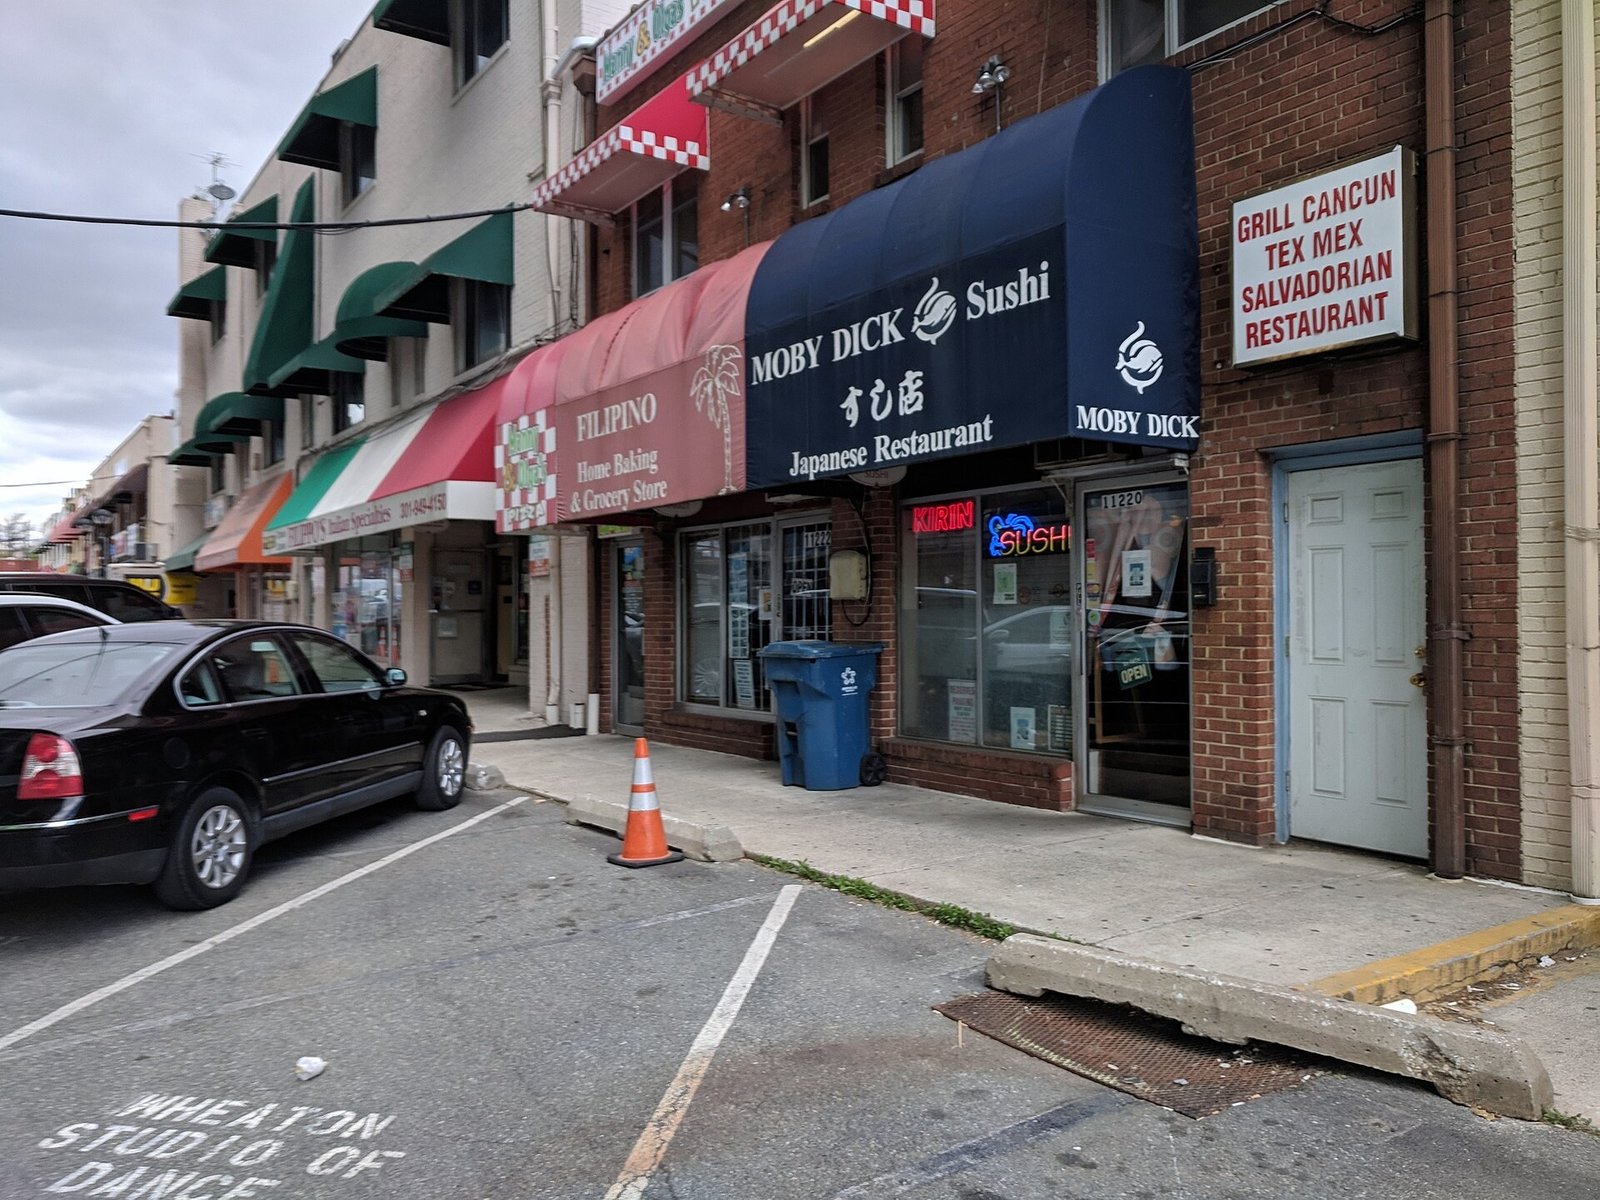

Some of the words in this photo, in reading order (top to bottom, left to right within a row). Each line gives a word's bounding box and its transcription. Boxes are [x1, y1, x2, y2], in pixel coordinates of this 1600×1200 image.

[1238, 203, 1295, 243] GRILL
[1302, 169, 1396, 224] CANCUN
[1265, 236, 1305, 271] TEX
[1313, 218, 1364, 259] MEX
[1242, 250, 1393, 313] SALVADORIAN
[751, 335, 823, 385] MOBY
[831, 308, 906, 362] DICK
[966, 260, 1051, 320] Sushi
[1246, 291, 1389, 349] RESTAURANT
[577, 393, 657, 442] FILIPINO
[1076, 405, 1142, 435] MOBY
[1147, 413, 1200, 438] DICK
[577, 460, 611, 484] Home
[613, 448, 658, 476] Baking
[789, 445, 868, 480] Japanese
[874, 414, 994, 463] Restaurant
[507, 502, 547, 524] PIZZA
[570, 491, 581, 513] &
[582, 488, 632, 511] Grocery
[633, 479, 668, 503] Store
[912, 501, 975, 532] KIRIN
[1102, 491, 1142, 509] 11220
[804, 531, 832, 548] 11222
[1121, 663, 1148, 684] OPEN
[114, 1094, 398, 1140] WHEATON
[38, 1123, 285, 1167] STUDIO
[306, 1146, 407, 1179] OF
[43, 1161, 283, 1200] DANCE
